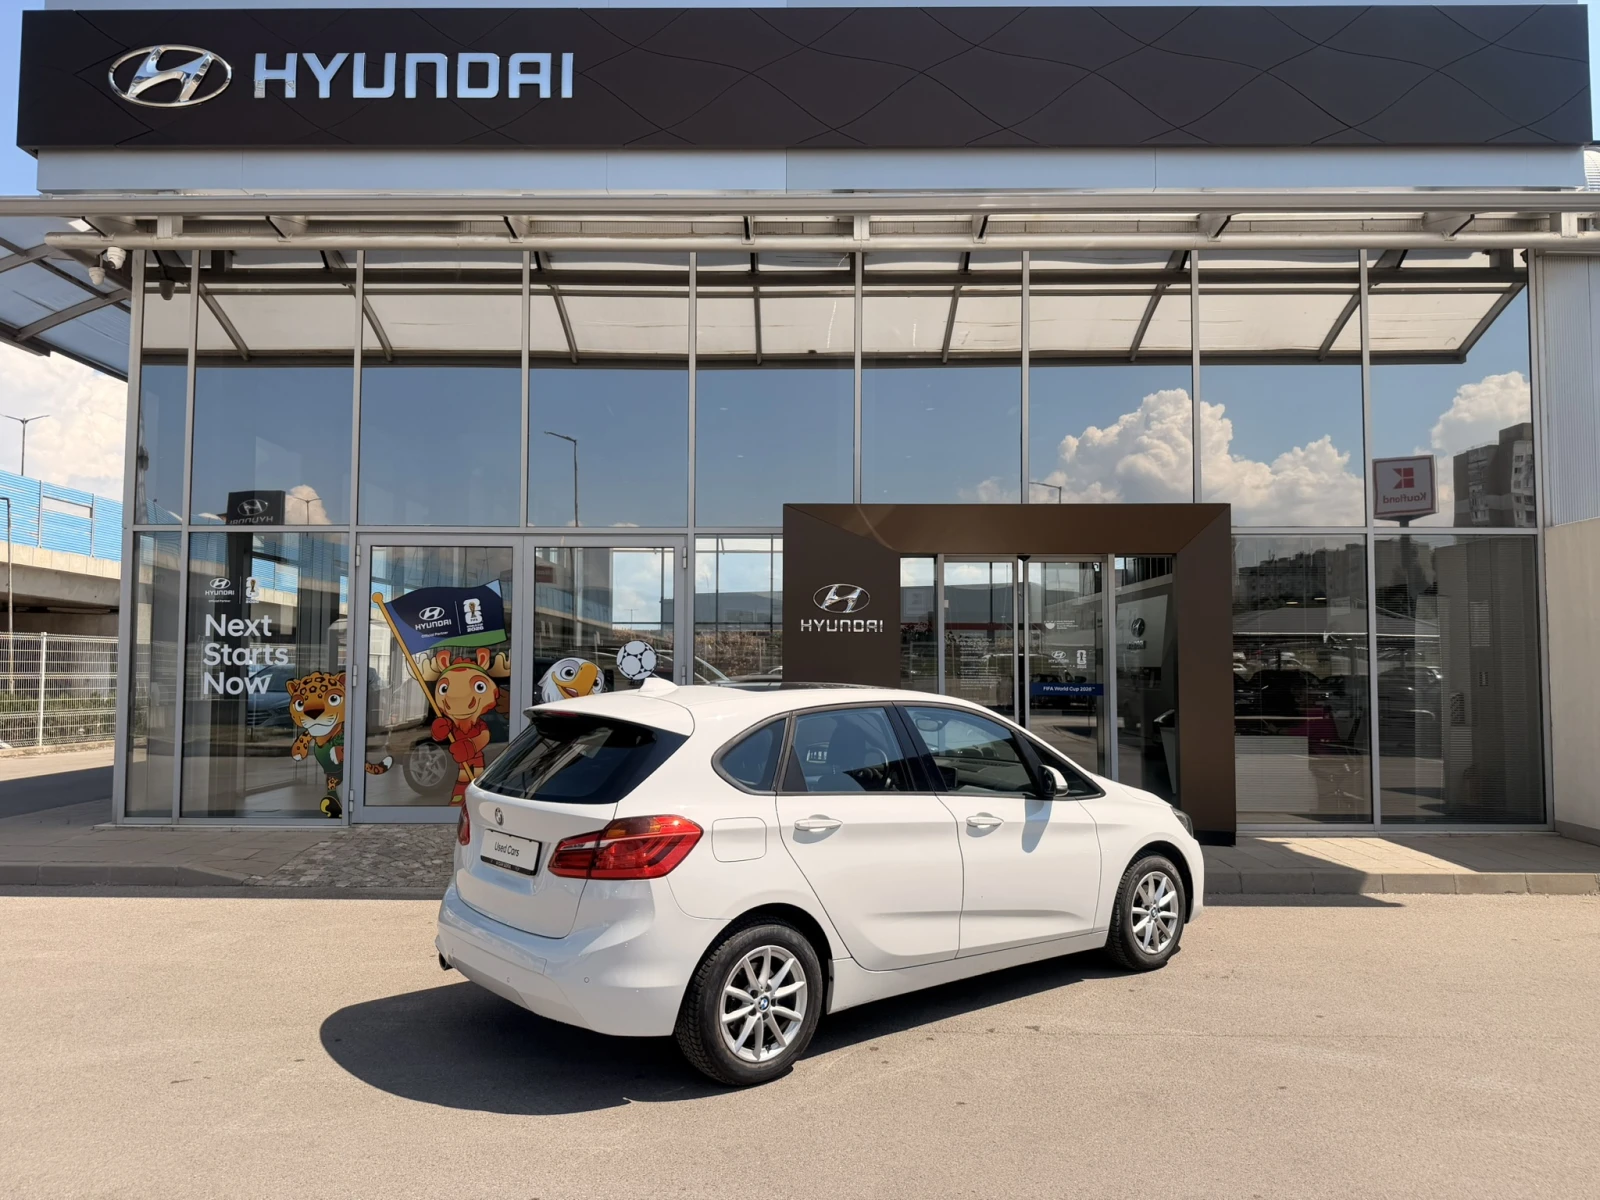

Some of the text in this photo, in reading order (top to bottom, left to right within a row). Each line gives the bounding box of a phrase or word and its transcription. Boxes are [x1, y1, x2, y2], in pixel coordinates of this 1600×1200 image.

[253, 52, 574, 99] HYUNDAI
[205, 613, 272, 637] Next
[415, 619, 452, 631] HYUNDAI
[800, 619, 884, 633] HYUNDAI
[203, 642, 289, 666] Starts
[203, 671, 272, 695] Now
[494, 842, 520, 857] Used Cars
